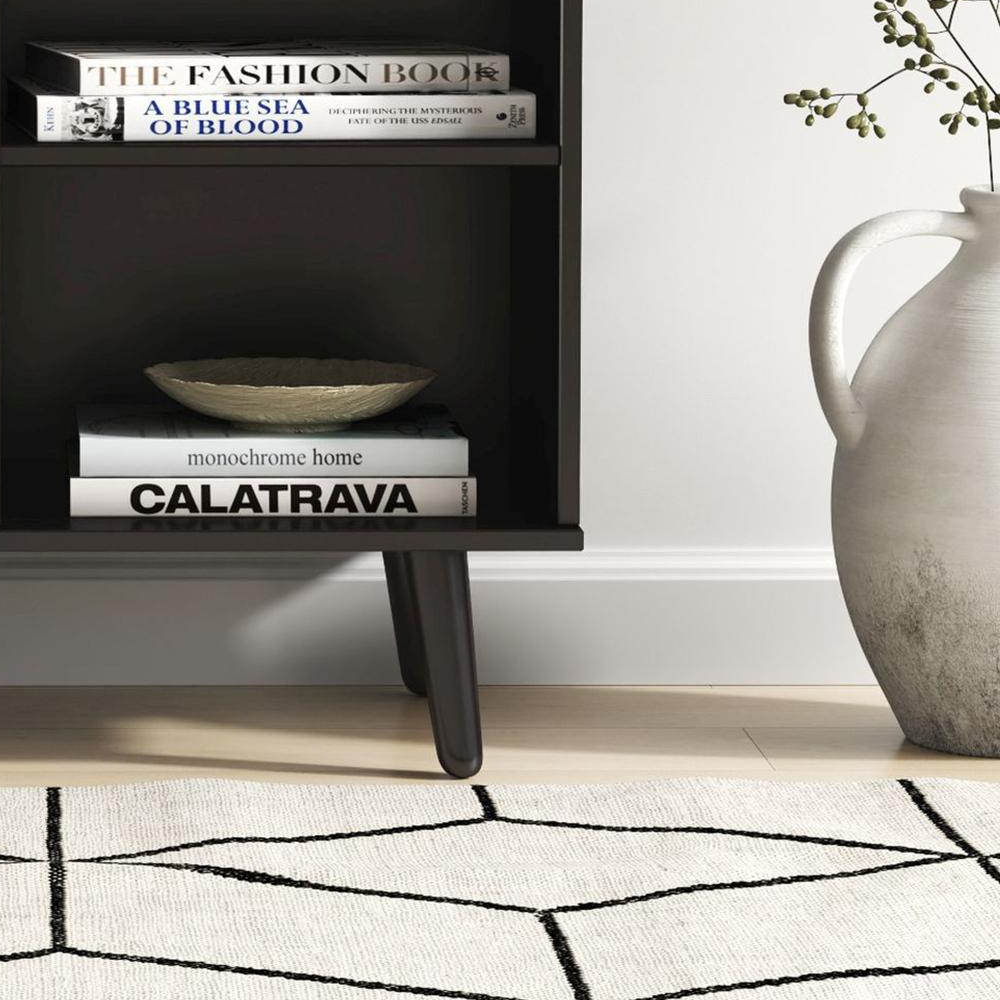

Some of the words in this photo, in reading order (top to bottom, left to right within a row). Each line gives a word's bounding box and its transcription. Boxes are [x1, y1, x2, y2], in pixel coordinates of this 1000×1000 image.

[87, 64, 176, 87] THE
[188, 63, 371, 86] FASHION
[383, 62, 502, 84] BOOK
[143, 99, 165, 116] A
[174, 99, 250, 116] BLUE
[257, 99, 310, 116] SEA
[328, 107, 397, 115] DECIPHERING
[398, 107, 417, 115] THE
[420, 107, 483, 115] MYSTERIOUS
[149, 119, 190, 136] OF
[198, 119, 304, 136] BLOOD
[348, 117, 372, 125] FATE
[373, 117, 388, 125] OF
[389, 117, 409, 125] THE
[187, 448, 306, 467] monochrome
[312, 448, 363, 467] home
[130, 483, 418, 515] CALATRAVA
[460, 481, 468, 515] TASCHEN
